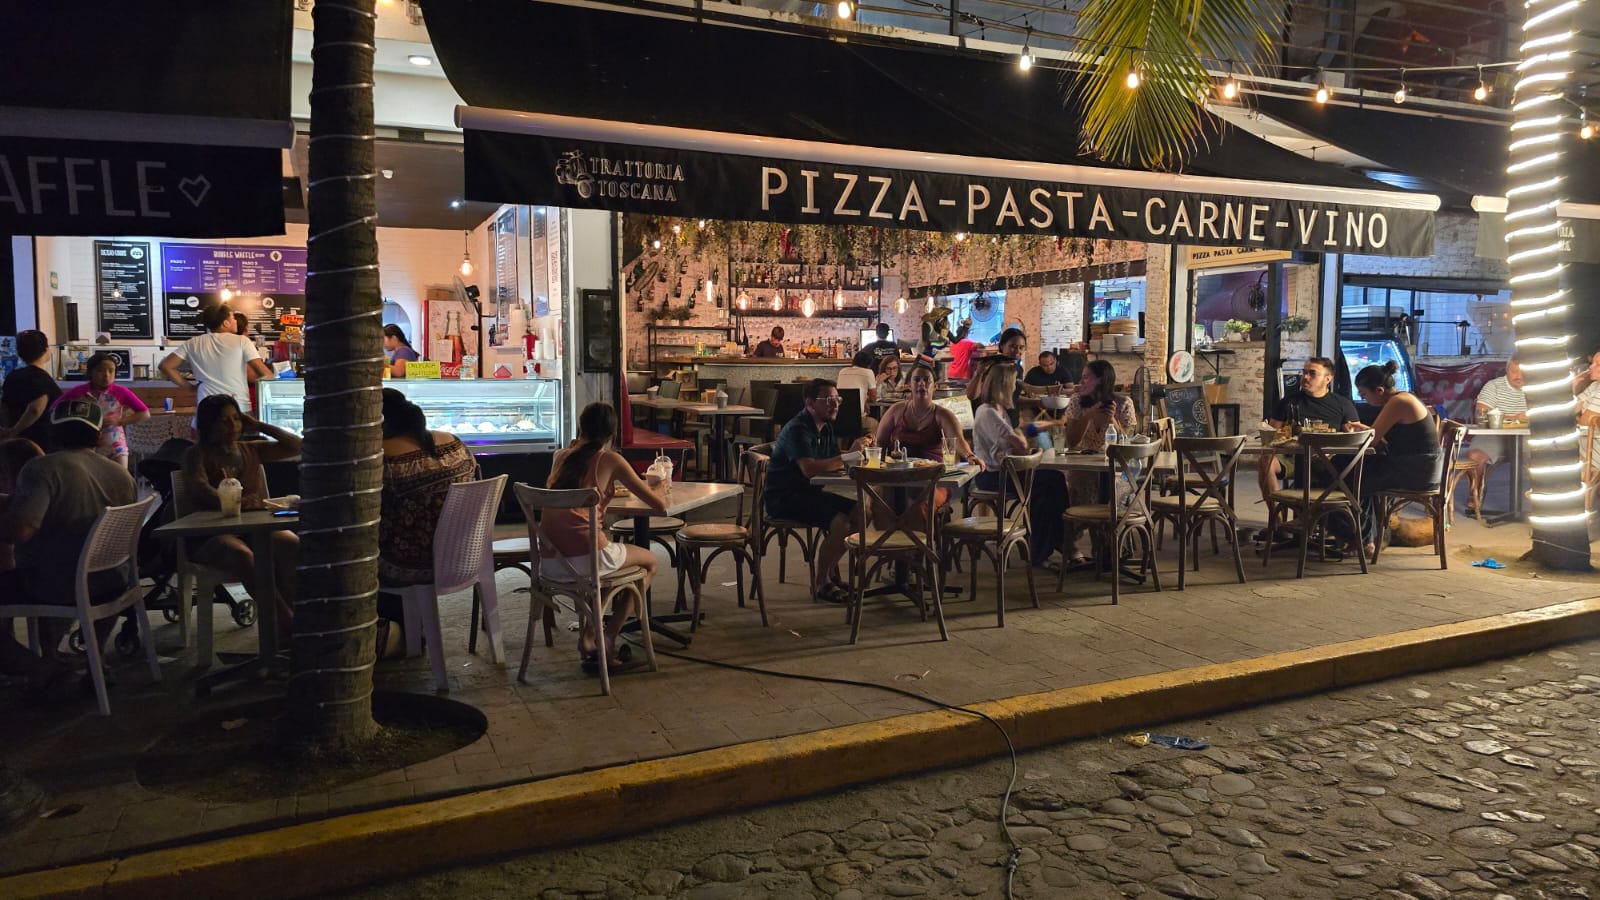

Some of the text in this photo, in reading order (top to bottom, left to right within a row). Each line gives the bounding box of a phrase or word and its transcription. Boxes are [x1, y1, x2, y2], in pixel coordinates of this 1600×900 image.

[589, 157, 684, 181] TRATTORIA
[598, 180, 677, 202] TOSCANA
[1192, 252, 1210, 260] PIZZA
[1213, 248, 1233, 257] PASTA
